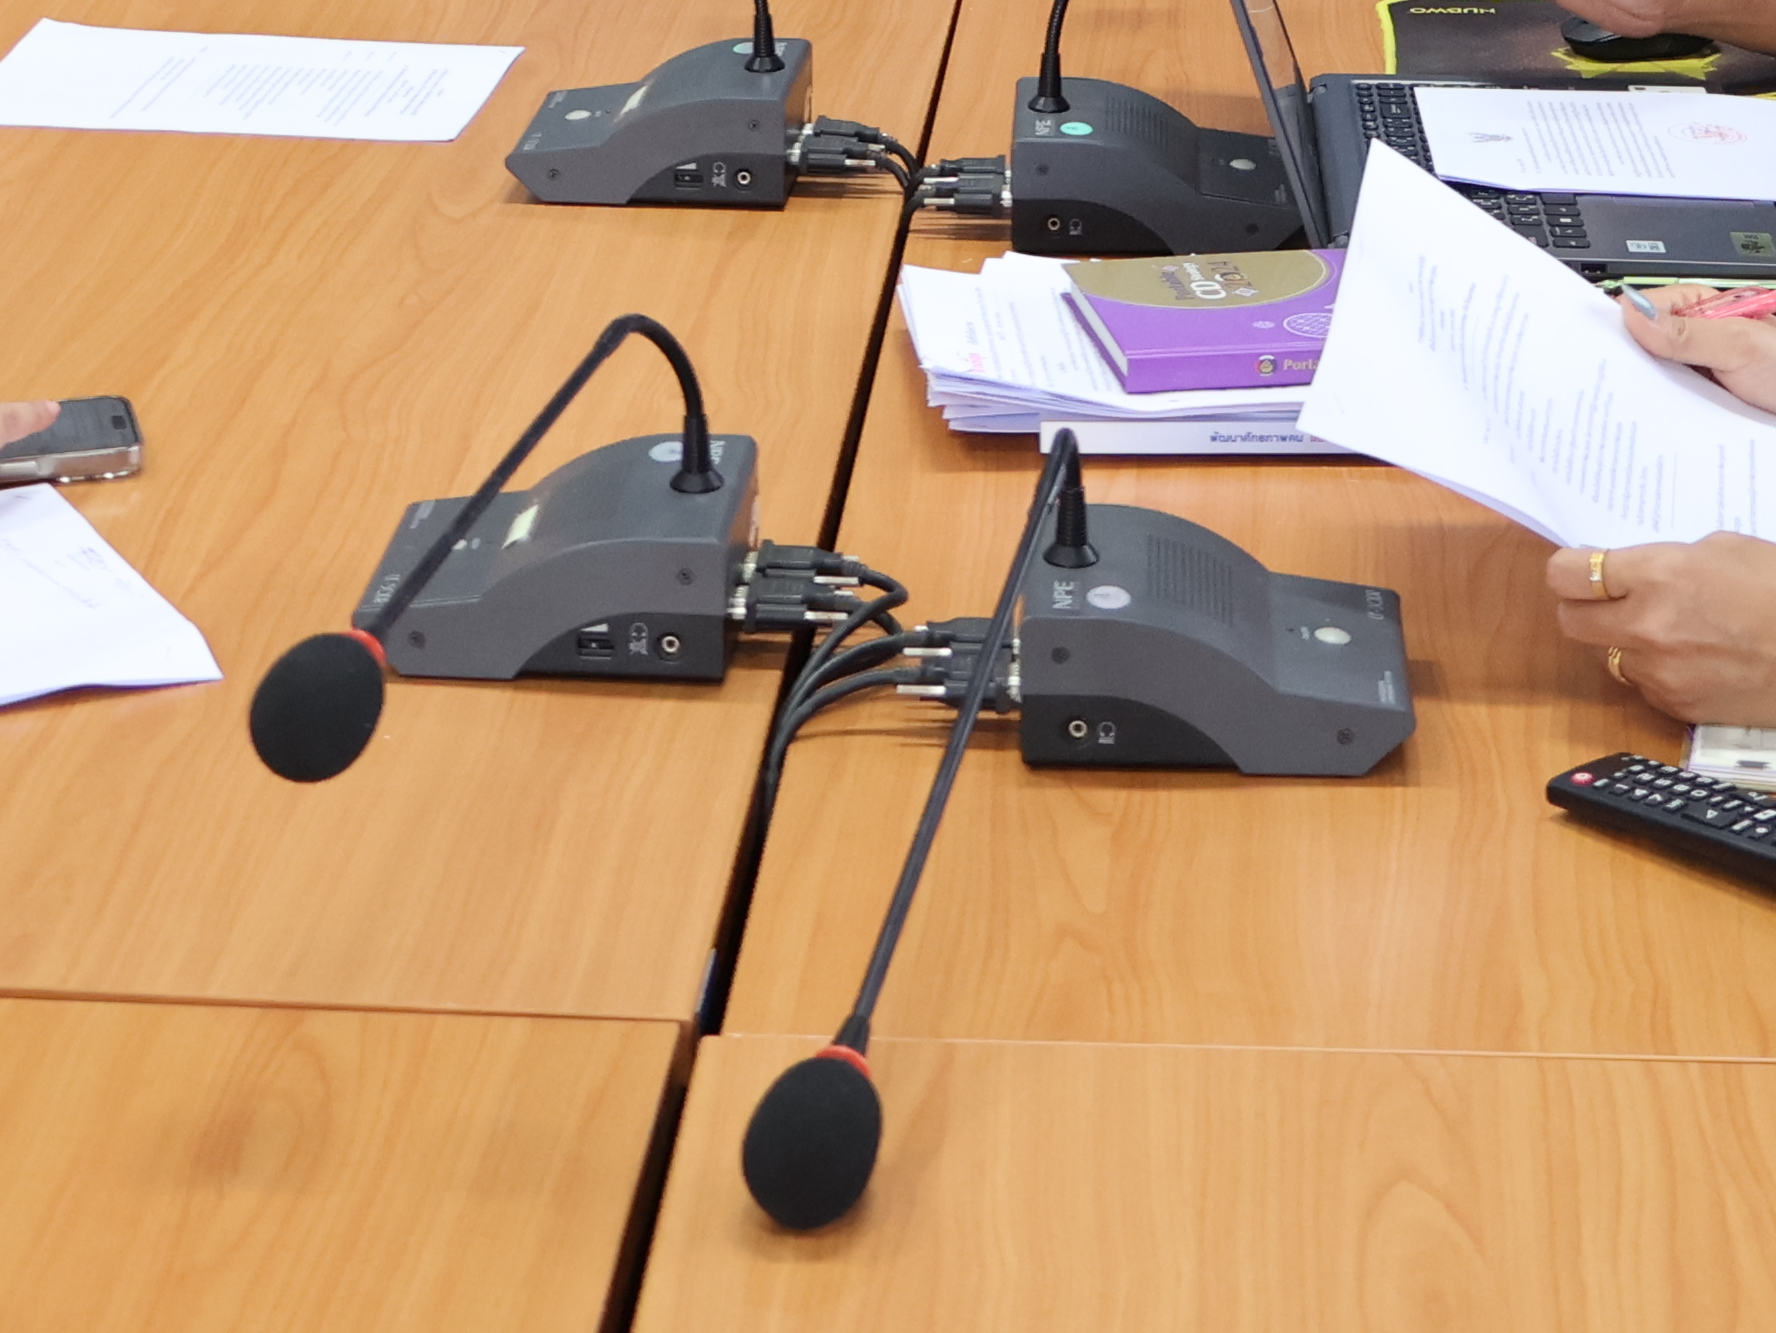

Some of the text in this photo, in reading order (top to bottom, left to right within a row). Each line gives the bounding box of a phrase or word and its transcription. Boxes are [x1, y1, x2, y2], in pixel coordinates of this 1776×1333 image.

[1190, 281, 1227, 300] CD
[1284, 359, 1319, 371] Porta
[1052, 580, 1075, 610] NPE
